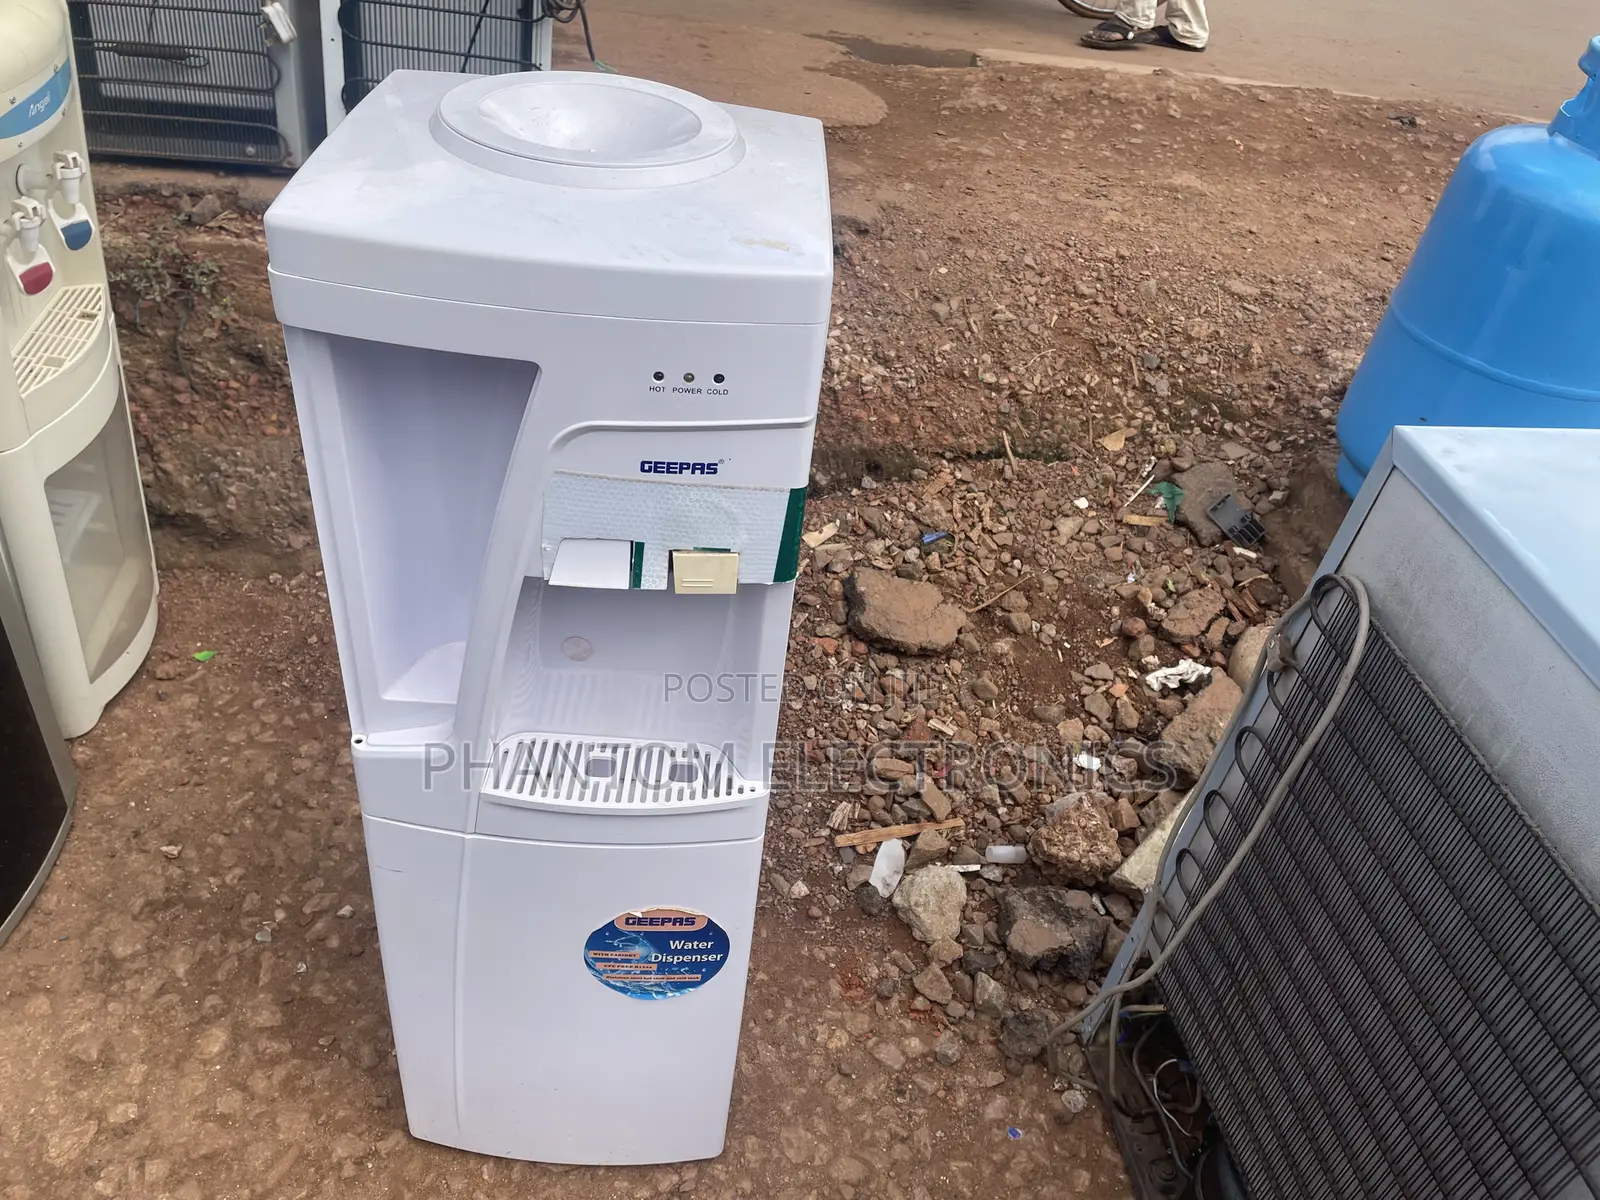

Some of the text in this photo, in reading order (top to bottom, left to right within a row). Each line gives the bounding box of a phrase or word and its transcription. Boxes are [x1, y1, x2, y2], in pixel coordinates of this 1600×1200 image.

[28, 91, 51, 118] Angel
[648, 385, 666, 393] HOT
[672, 387, 703, 395] POWER
[706, 388, 729, 396] COLD
[640, 460, 719, 475] GEEPAS
[624, 916, 697, 927] GEEPAS
[669, 939, 715, 950] Water
[651, 952, 724, 965] Dispenser
